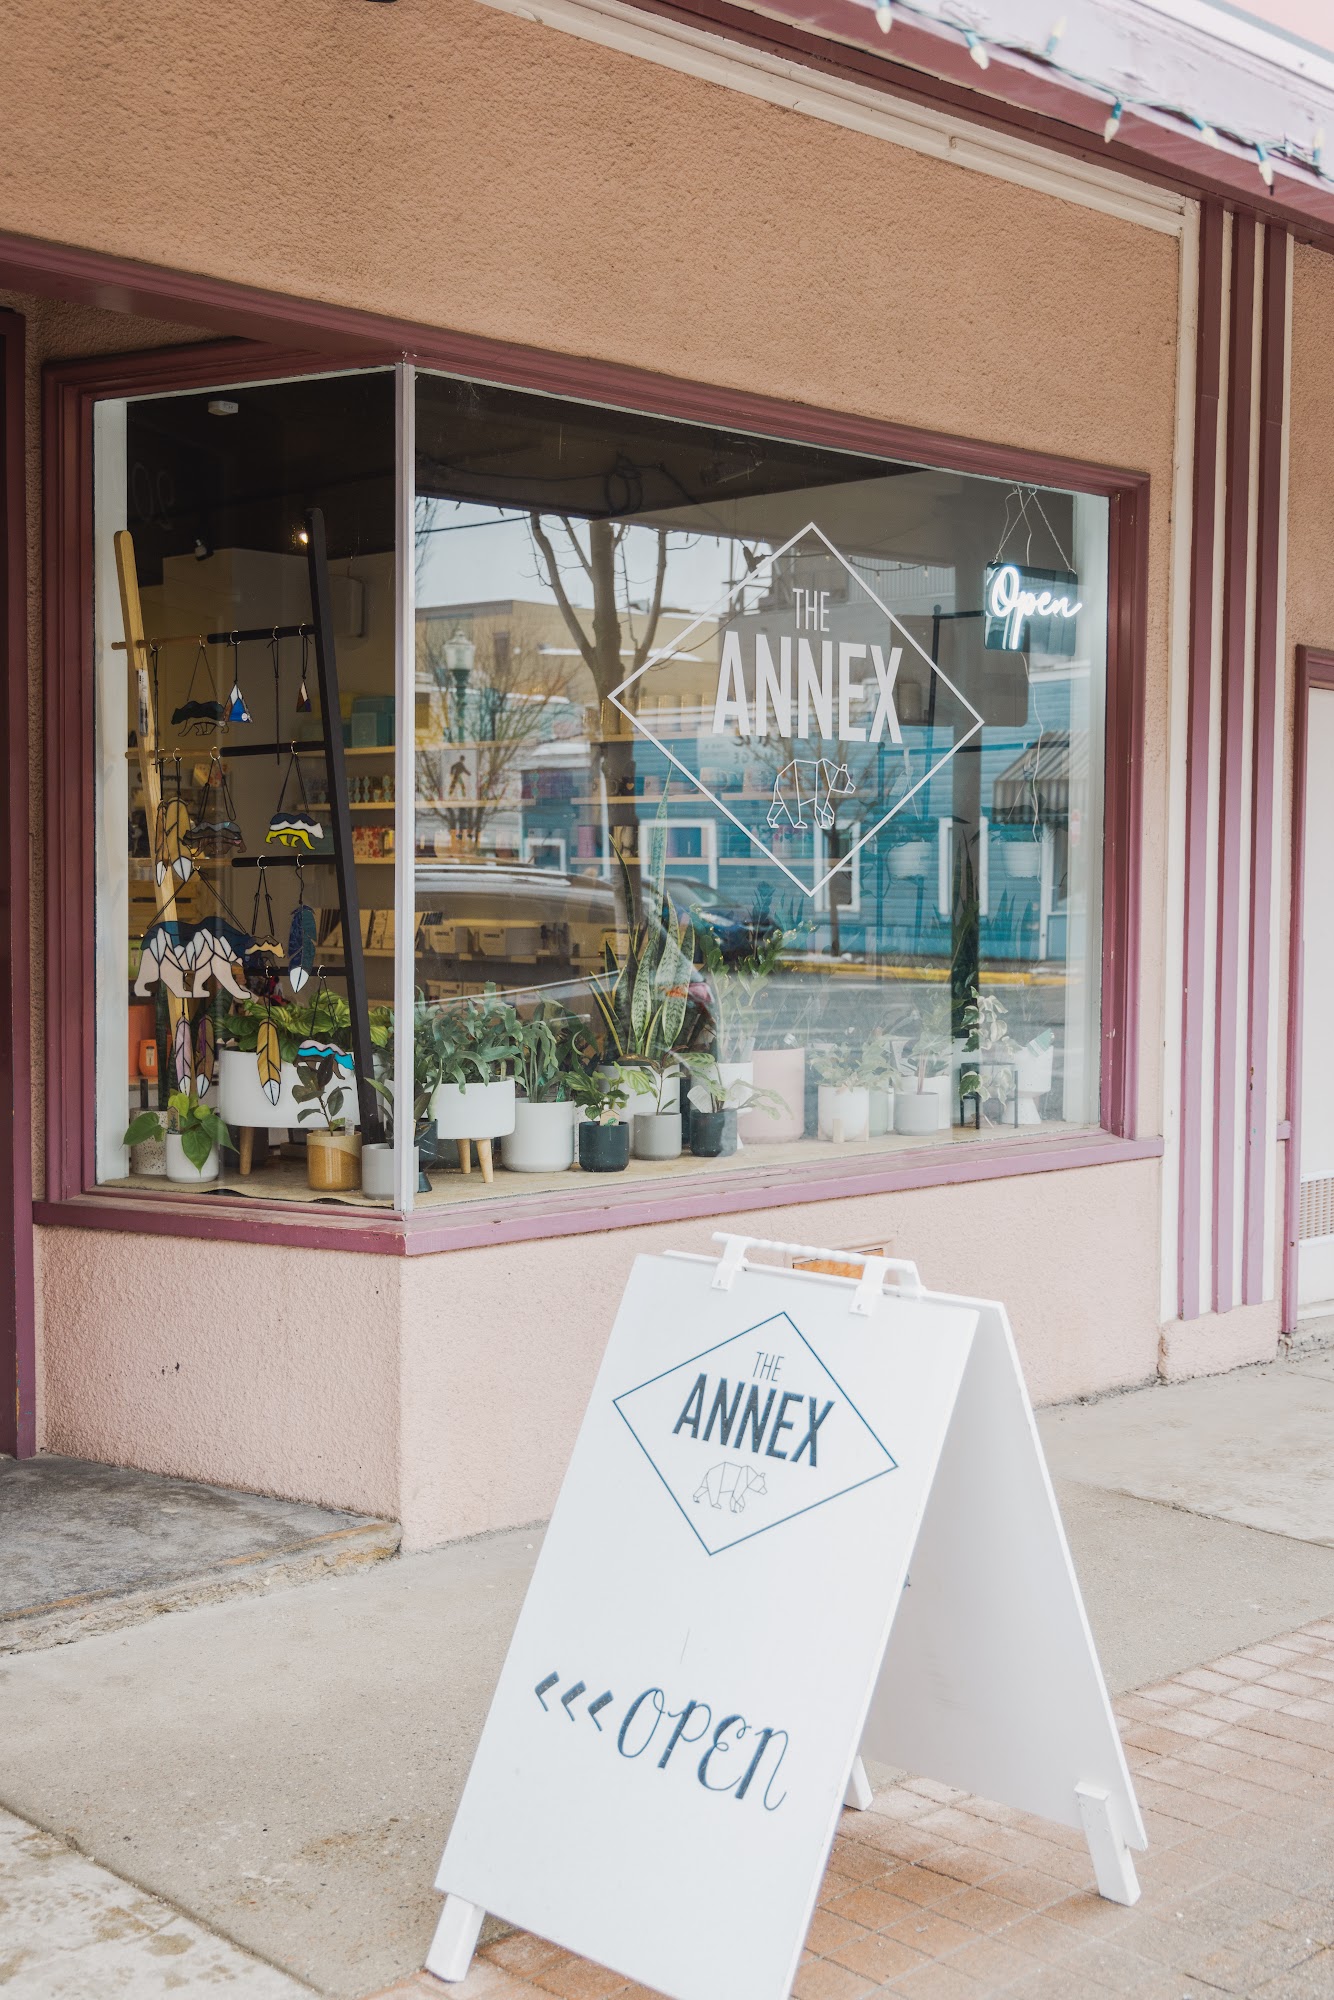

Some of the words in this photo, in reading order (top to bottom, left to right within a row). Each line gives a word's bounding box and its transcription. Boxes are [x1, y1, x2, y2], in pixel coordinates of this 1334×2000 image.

[792, 587, 831, 633] THE
[990, 565, 1083, 651] Open
[712, 630, 904, 744] ANNEX
[753, 1351, 786, 1383] THE
[671, 1372, 836, 1468] ANNEX
